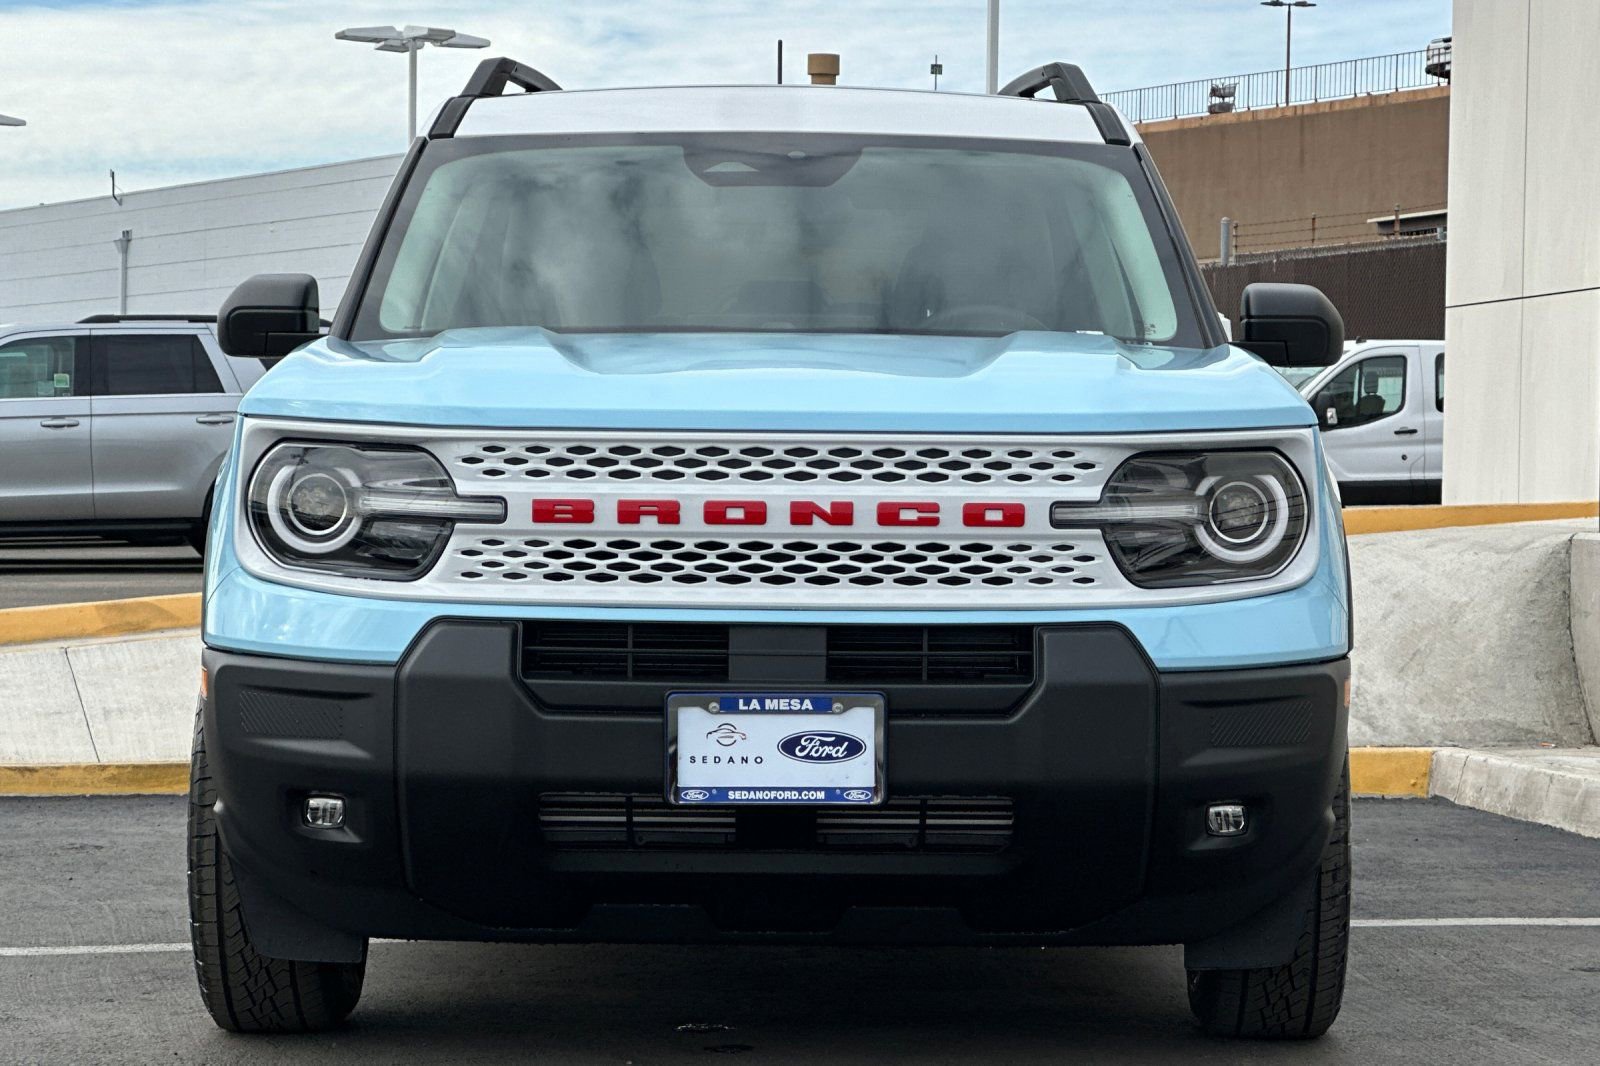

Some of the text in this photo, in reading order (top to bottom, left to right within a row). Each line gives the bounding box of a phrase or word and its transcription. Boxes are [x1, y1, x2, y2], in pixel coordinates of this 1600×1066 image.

[532, 499, 1025, 527] BRONCO
[738, 698, 813, 711] LA MESA
[795, 735, 848, 758] Ford
[690, 755, 763, 764] SEDANO
[685, 791, 705, 799] Ford
[728, 791, 825, 800] SEDANOFORD.COM
[847, 791, 867, 799] Ford
